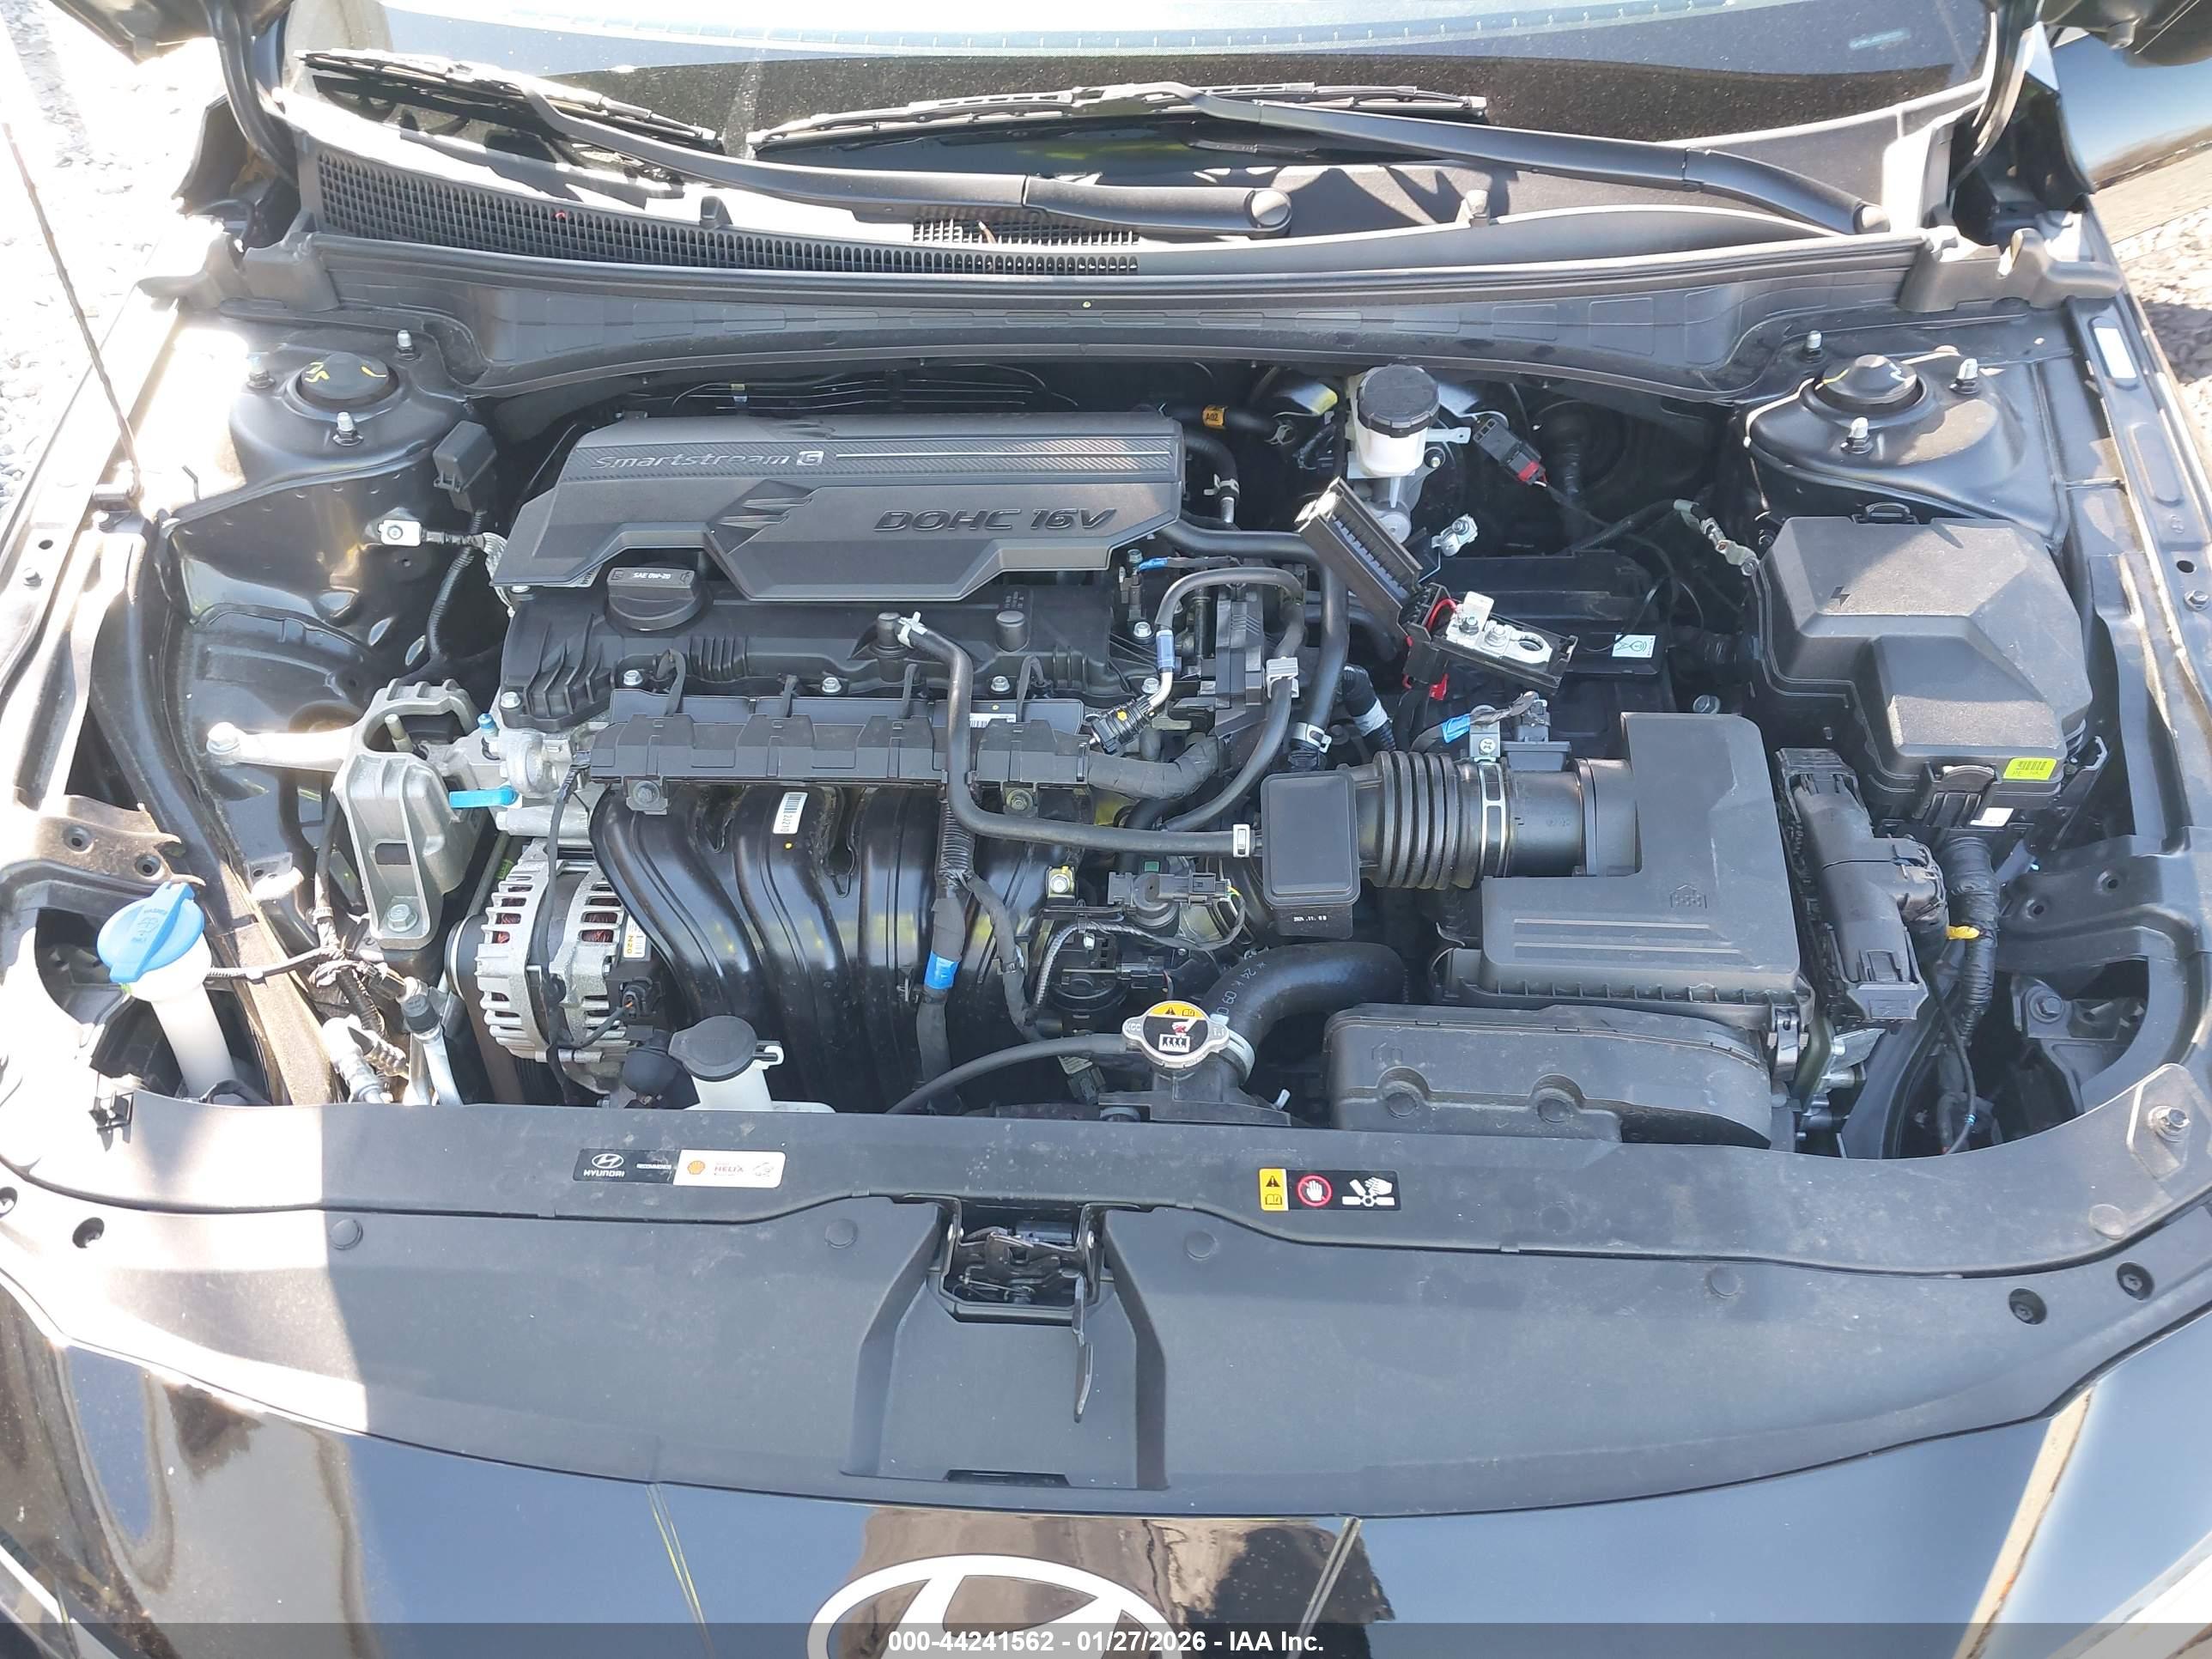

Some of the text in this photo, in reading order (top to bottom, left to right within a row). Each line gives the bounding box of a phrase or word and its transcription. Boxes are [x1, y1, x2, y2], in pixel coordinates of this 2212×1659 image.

[591, 453, 790, 470] Smartstream
[872, 507, 1117, 532] DOHC 16V
[583, 1169, 625, 1177] HYUNDAI
